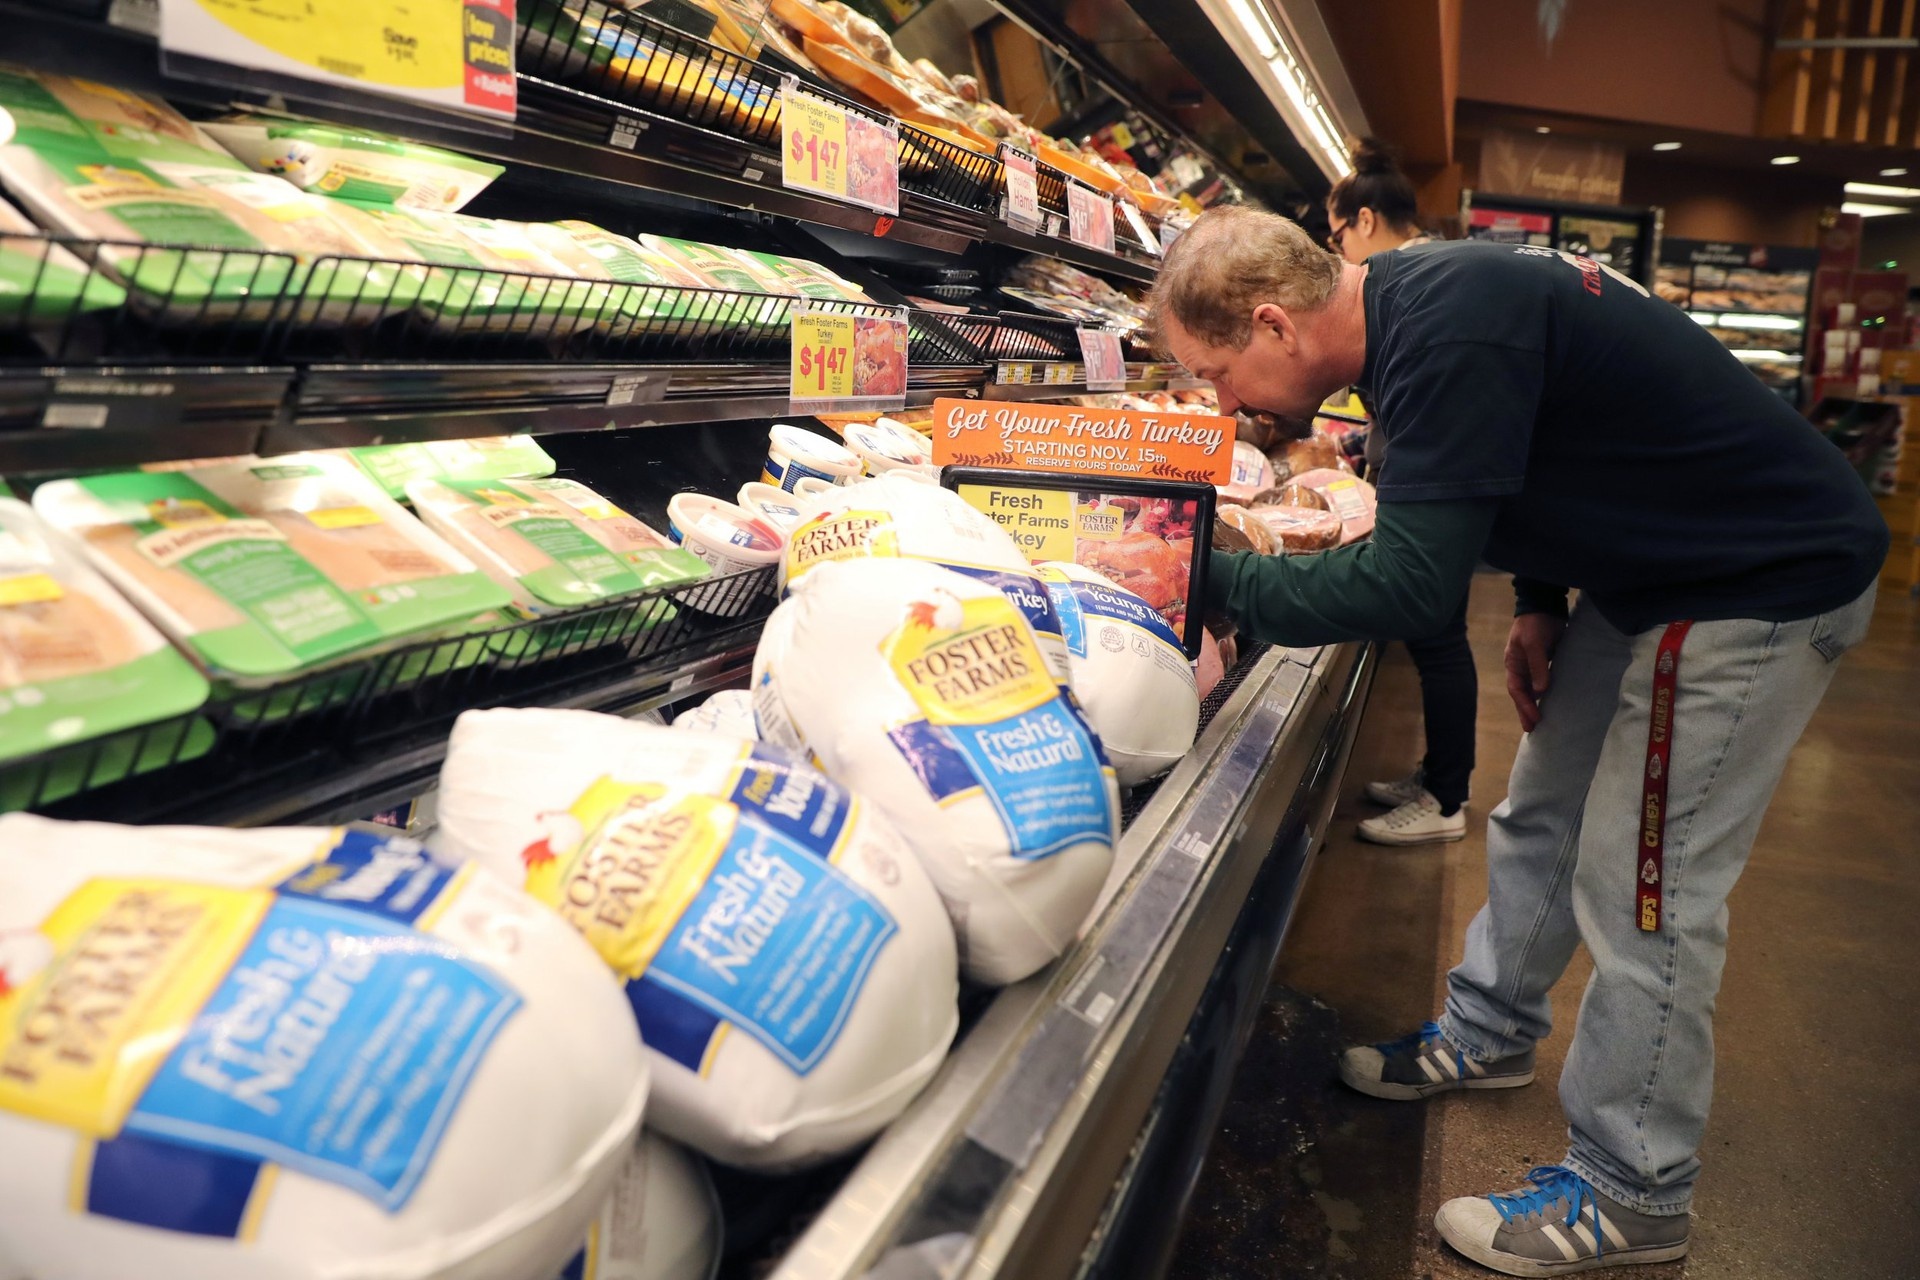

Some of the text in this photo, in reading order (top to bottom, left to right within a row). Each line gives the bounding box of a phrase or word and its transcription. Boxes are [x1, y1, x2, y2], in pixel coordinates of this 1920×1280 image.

[383, 27, 418, 49] Save
[791, 99, 840, 124] Fresh Foster Farms
[808, 116, 825, 130] Turkey
[1014, 191, 1034, 212] Hams
[800, 317, 848, 329] Fresh Foster Farms
[817, 329, 833, 340] Turkey
[947, 406, 1224, 455] Get Your Fresh Turkey
[1003, 439, 1168, 465] STARTING NOV. 15th
[1026, 457, 1142, 474] RESERVE YOURS TODAY
[989, 491, 1043, 510] Fresh
[1018, 514, 1069, 529] Farms
[1079, 514, 1118, 525] FOSTER
[1082, 524, 1114, 533] FARMS
[793, 519, 879, 552] FOSTER
[1084, 583, 1116, 595] Fresh
[1085, 588, 1146, 619] Young
[1095, 604, 1115, 614] TENDER
[1116, 608, 1126, 617] AND
[906, 624, 1026, 685] FOSTER
[933, 652, 1030, 703] FARMS
[1653, 686, 1671, 743] CHIEFS
[974, 713, 1061, 753] Fresh &
[988, 731, 1084, 776] Natural
[1645, 792, 1660, 848] CHIEFS
[596, 811, 691, 930] FARMS
[678, 871, 758, 961] Fresh
[708, 854, 806, 986] Natural
[1641, 894, 1657, 931] IEFS
